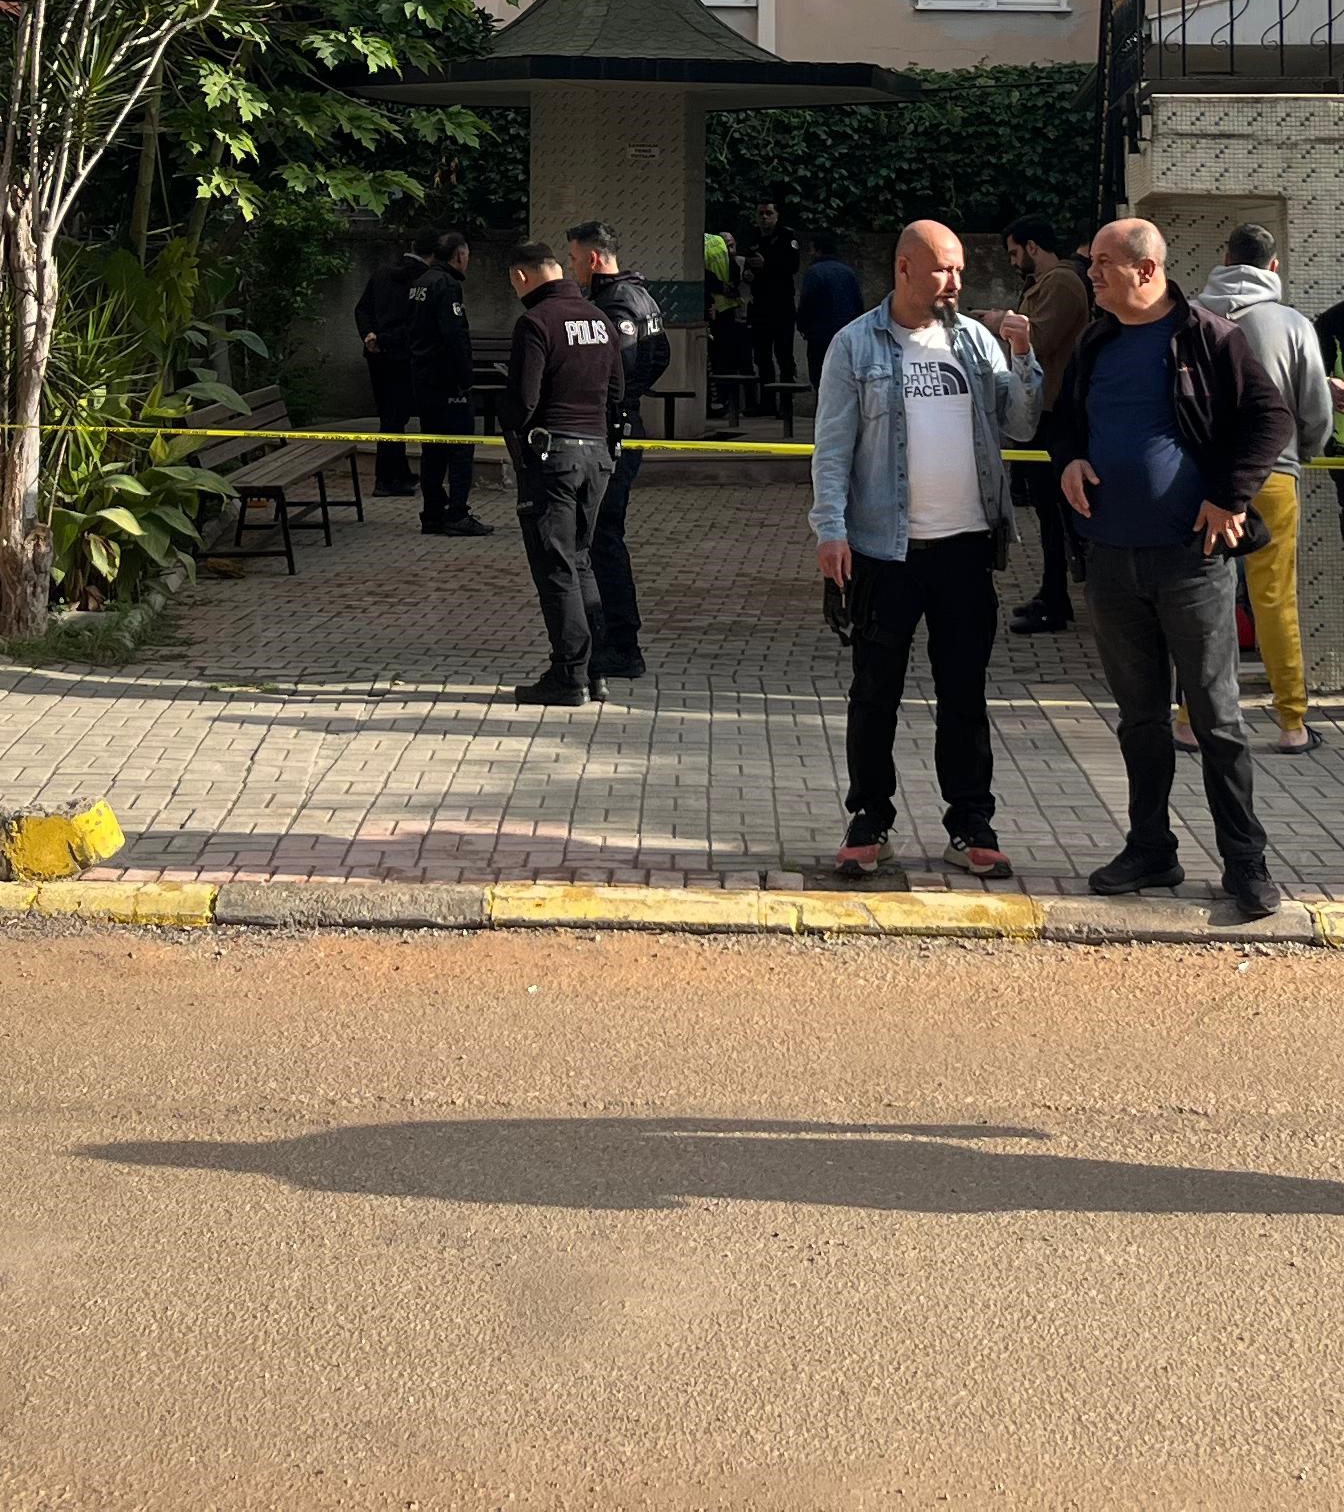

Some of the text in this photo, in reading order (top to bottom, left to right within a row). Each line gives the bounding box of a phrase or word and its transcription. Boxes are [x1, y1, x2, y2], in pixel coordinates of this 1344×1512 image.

[910, 362, 936, 374] THE
[903, 373, 941, 385] ORTH
[904, 385, 942, 398] FACE
